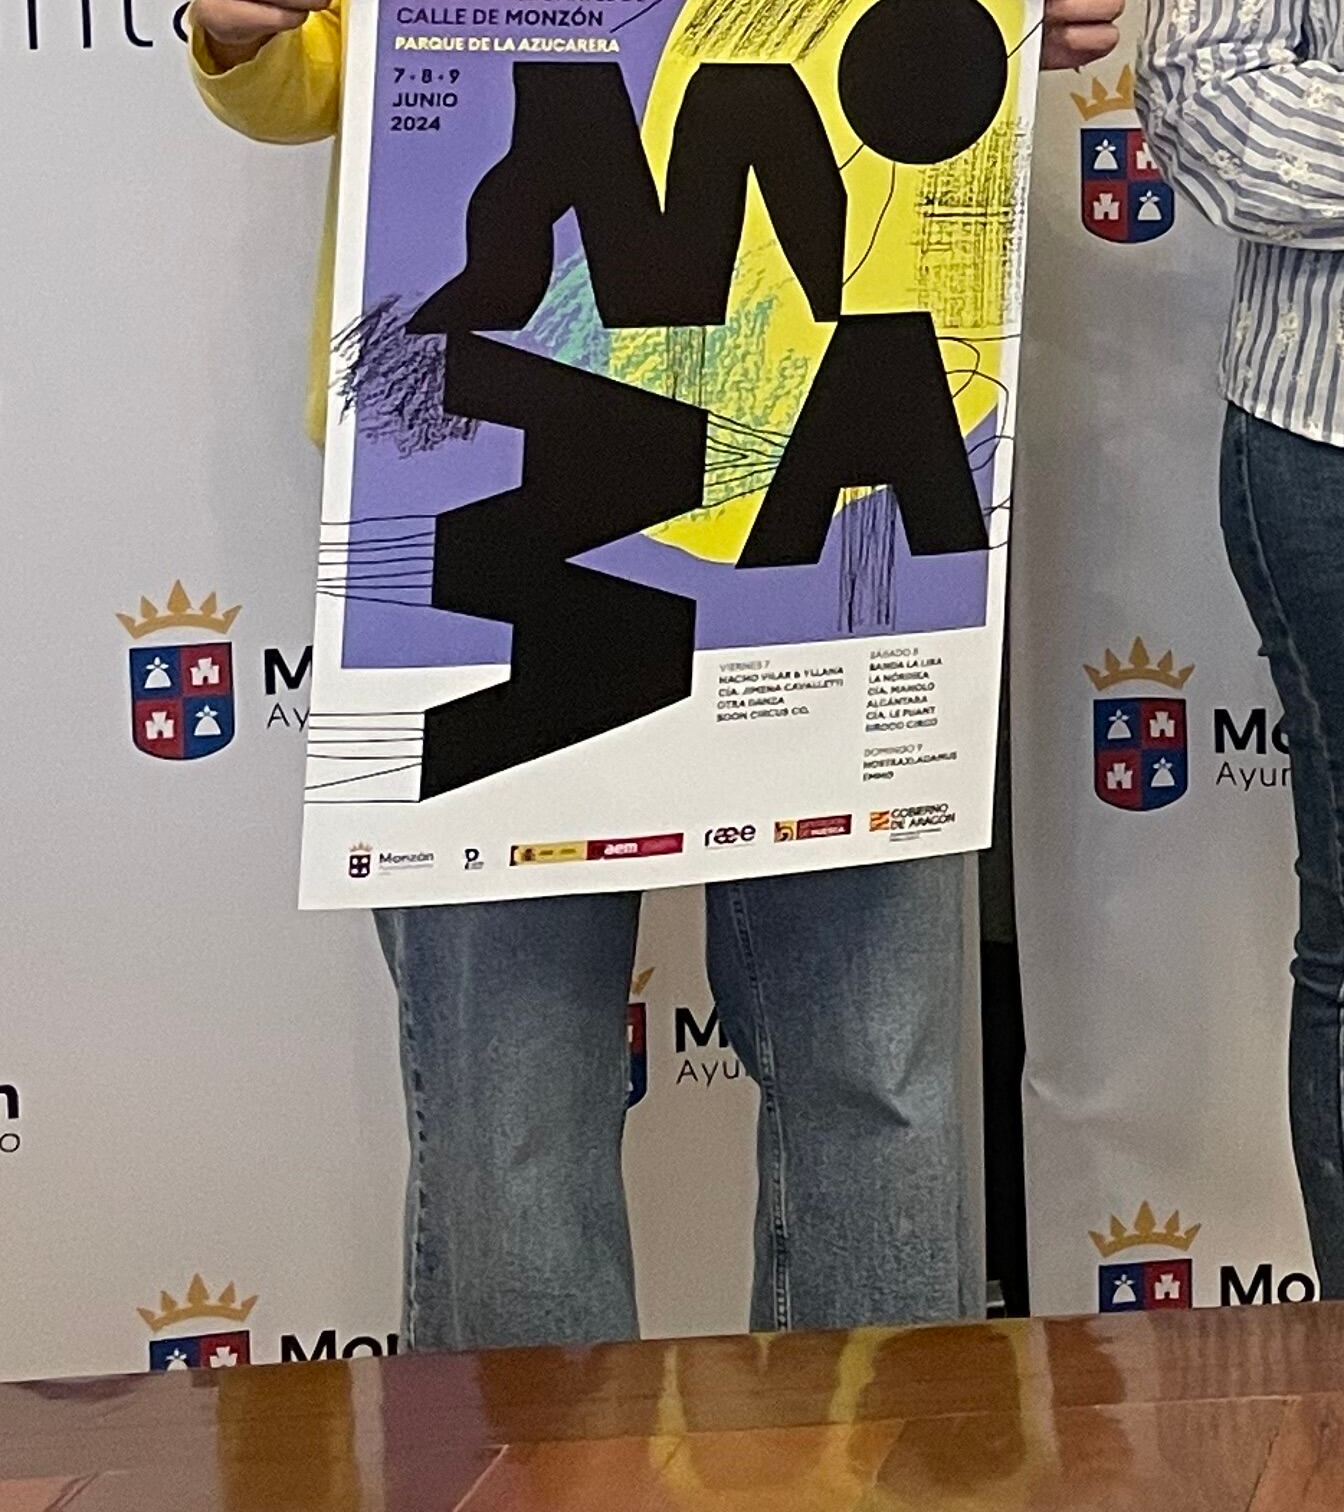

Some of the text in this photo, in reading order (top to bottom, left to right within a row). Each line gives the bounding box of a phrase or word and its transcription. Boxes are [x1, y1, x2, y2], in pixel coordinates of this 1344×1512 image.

[397, 6, 603, 27] CALLE DE MONZÓN
[395, 36, 620, 53] PARQUE DE LA AZUCARERA
[392, 92, 458, 108] JUNIO
[391, 116, 441, 132] 2024
